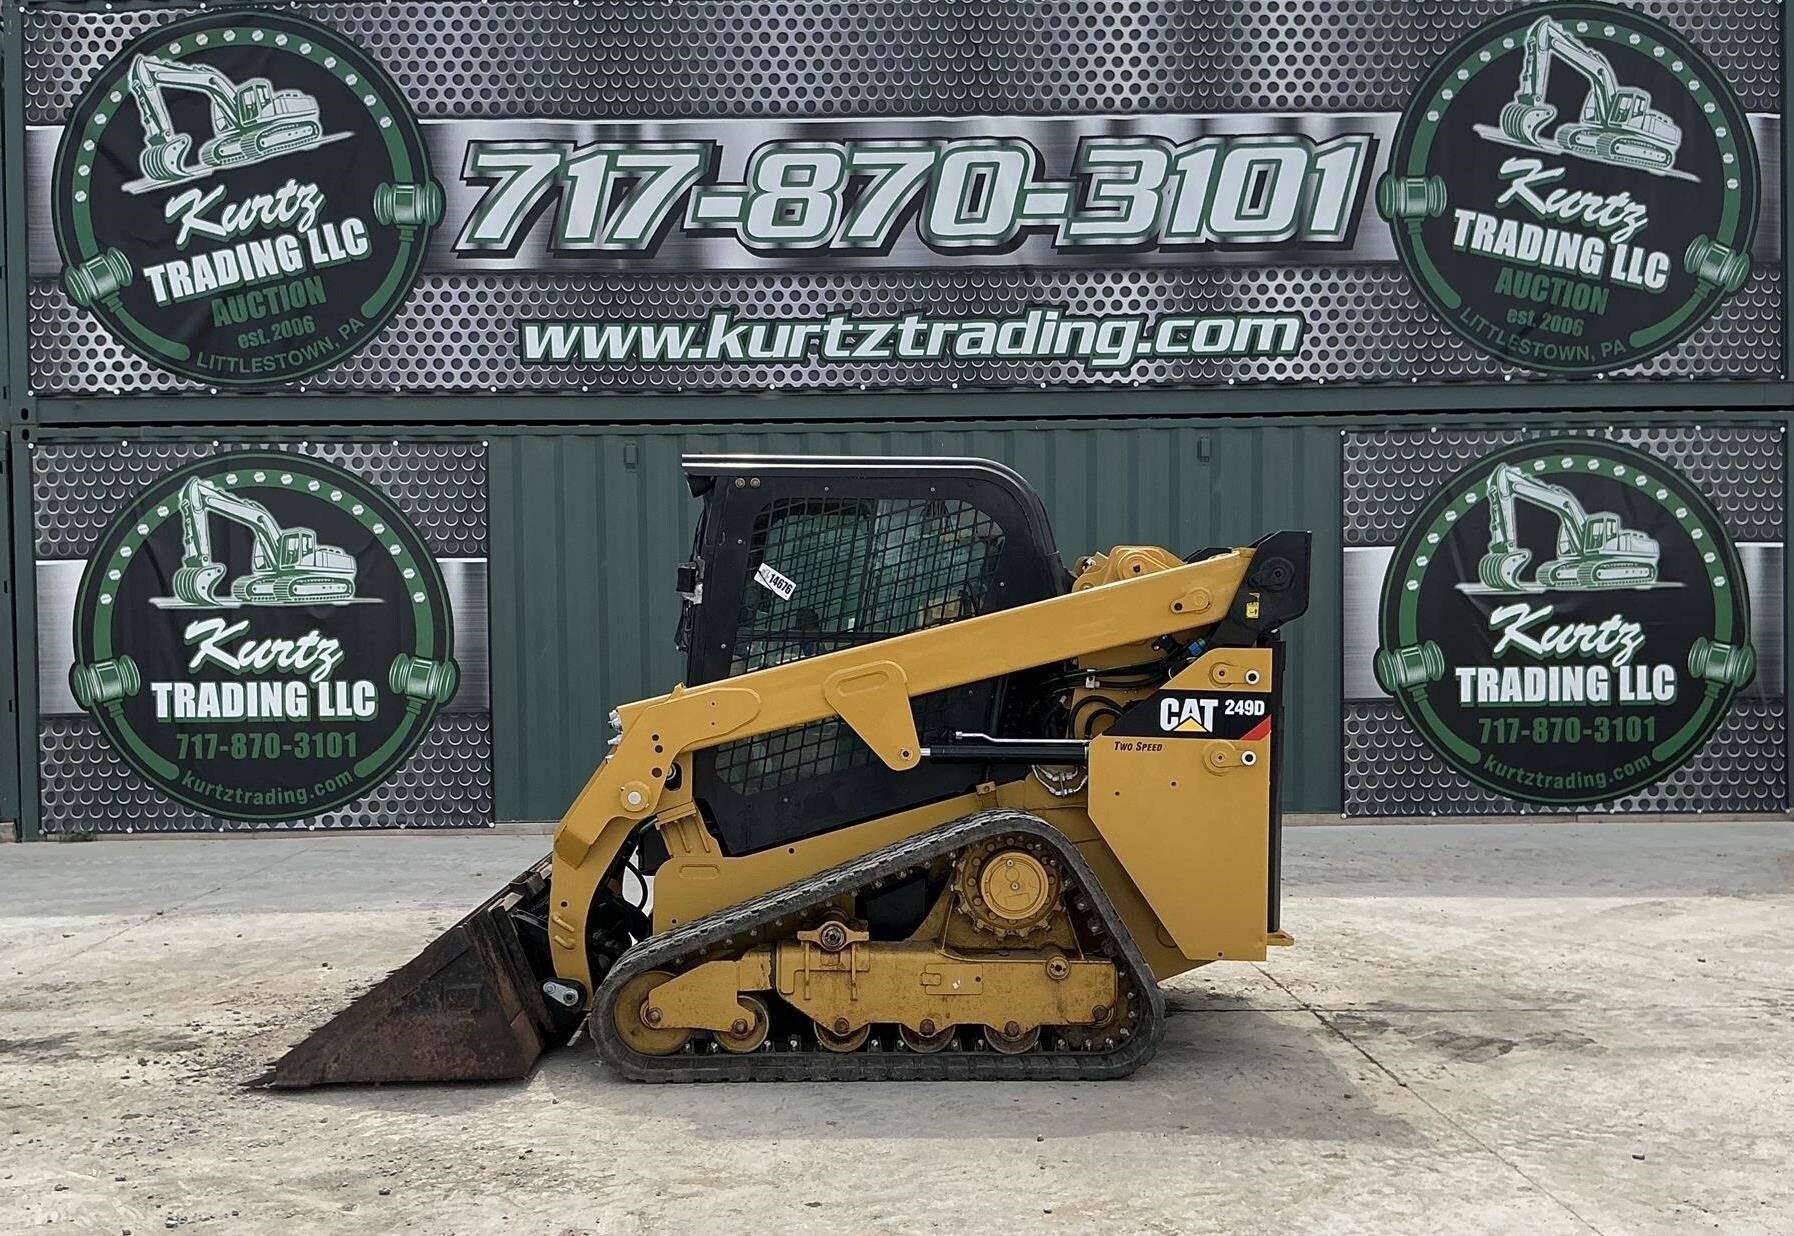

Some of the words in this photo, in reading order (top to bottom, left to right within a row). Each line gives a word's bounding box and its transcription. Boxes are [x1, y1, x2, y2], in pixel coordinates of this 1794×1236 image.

[165, 179, 325, 246] Kurtz
[464, 140, 1368, 251] 717-870-3101
[1497, 157, 1649, 244] Kurtz
[143, 234, 304, 303] TRADING
[307, 217, 369, 265] LLC
[1453, 208, 1605, 277] TRADING
[1611, 243, 1670, 290] LLC
[211, 276, 327, 328] AUCTION
[1494, 267, 1610, 316] AUCTION
[196, 336, 341, 373] LITTLESTOWN,
[338, 317, 365, 340] PA
[237, 329, 270, 349] est.
[272, 315, 316, 341] 2006
[521, 309, 1303, 369] www.kurtztrading.com
[1459, 307, 1596, 362] LITTLESTOWN,
[1600, 339, 1626, 357] PA
[1506, 308, 1536, 327] est.
[1539, 312, 1584, 336] 2006
[768, 573, 793, 595] 14676
[184, 617, 344, 684] Kurtz
[1489, 602, 1645, 668] Kurtz
[151, 681, 308, 718] TRADING
[318, 680, 376, 717] LLC
[1455, 665, 1609, 703] TRADING
[1619, 664, 1676, 702] LLC
[1160, 697, 1218, 732] CAT
[1224, 699, 1265, 716] 249D
[1478, 716, 1655, 744] 717-870-3101
[176, 732, 357, 760] 717-870-3101
[181, 770, 354, 805] kurtztrading.com
[1484, 753, 1652, 790] kurtztrading.com
